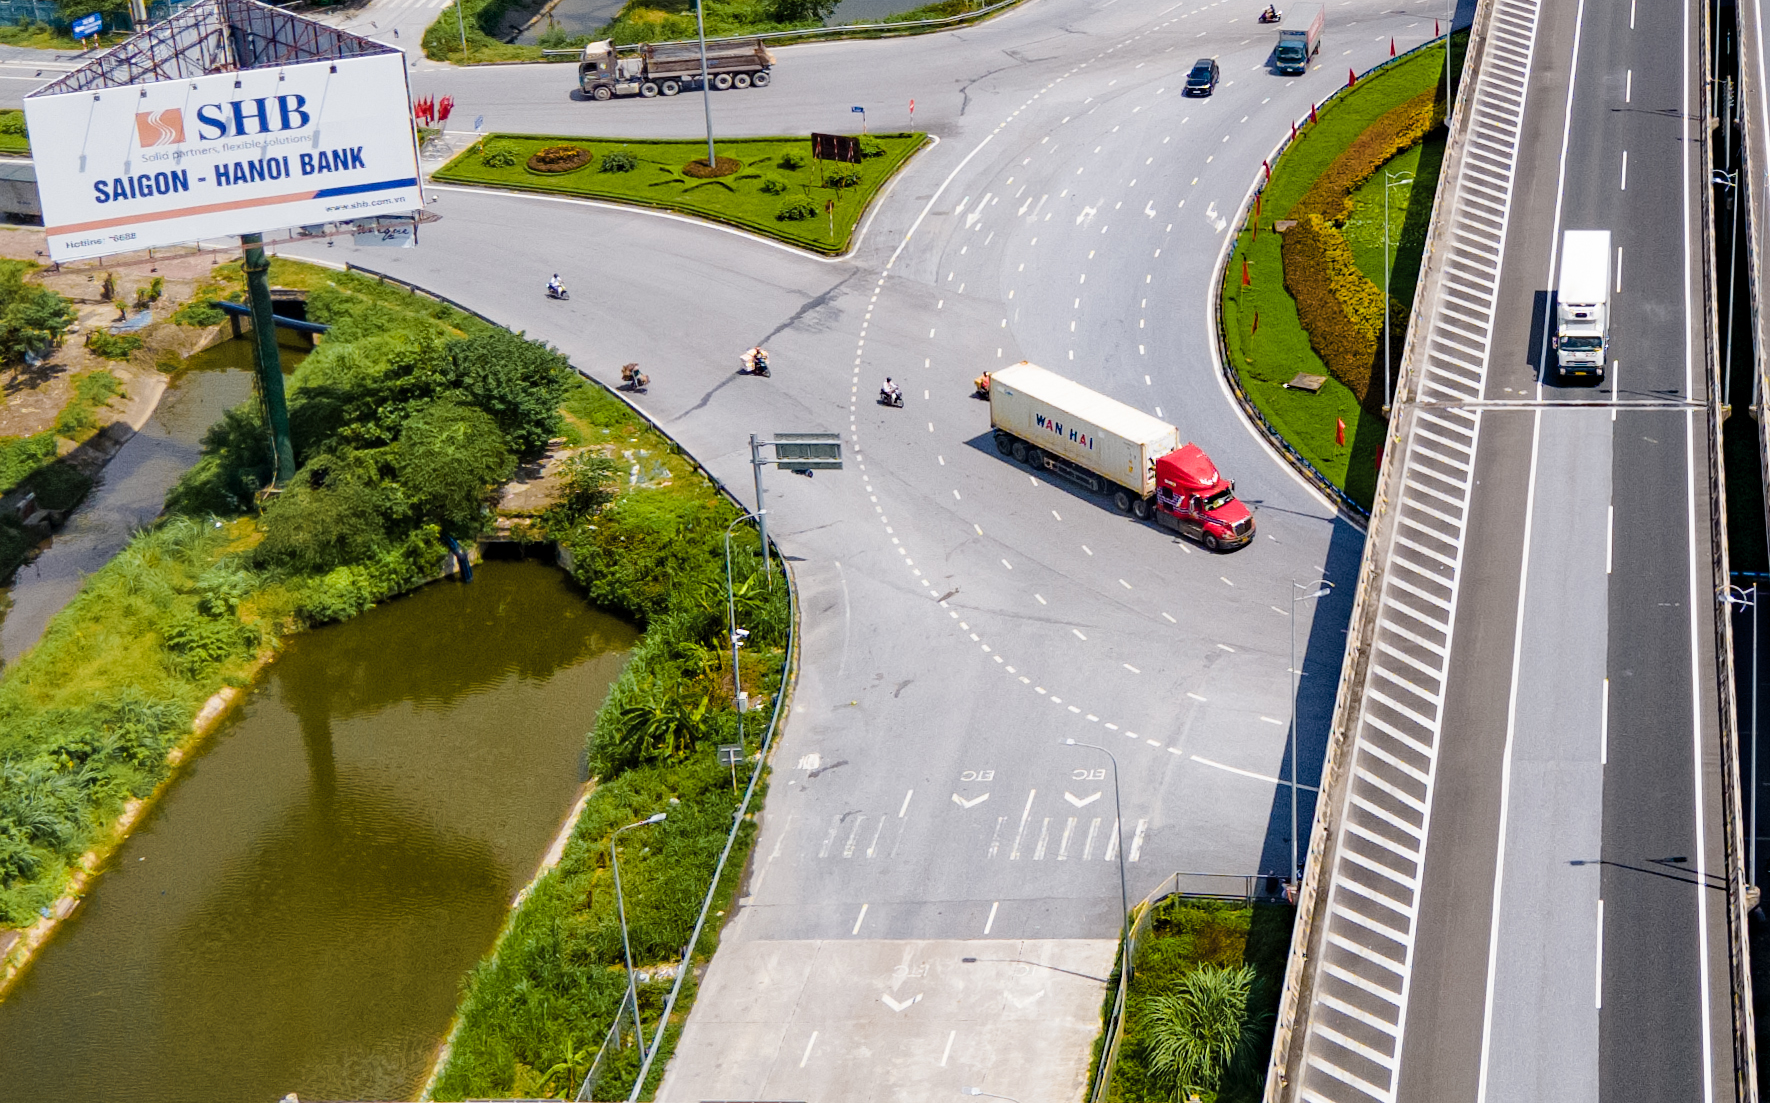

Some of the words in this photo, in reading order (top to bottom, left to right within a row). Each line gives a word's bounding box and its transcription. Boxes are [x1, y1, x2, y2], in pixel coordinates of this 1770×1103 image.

[197, 94, 311, 141] SHB
[142, 150, 169, 163] Solid
[172, 145, 221, 160] partners,
[222, 138, 261, 152] flexible
[263, 133, 312, 147] solutions
[93, 168, 189, 204] SAIGON
[214, 156, 290, 187] HANOI
[300, 145, 366, 177] BANK
[325, 196, 406, 212] www.shb.com.vn
[1035, 413, 1063, 436] WAN
[1070, 428, 1093, 450] HAI
[960, 770, 995, 781] ETC
[1072, 769, 1106, 780] ETC
